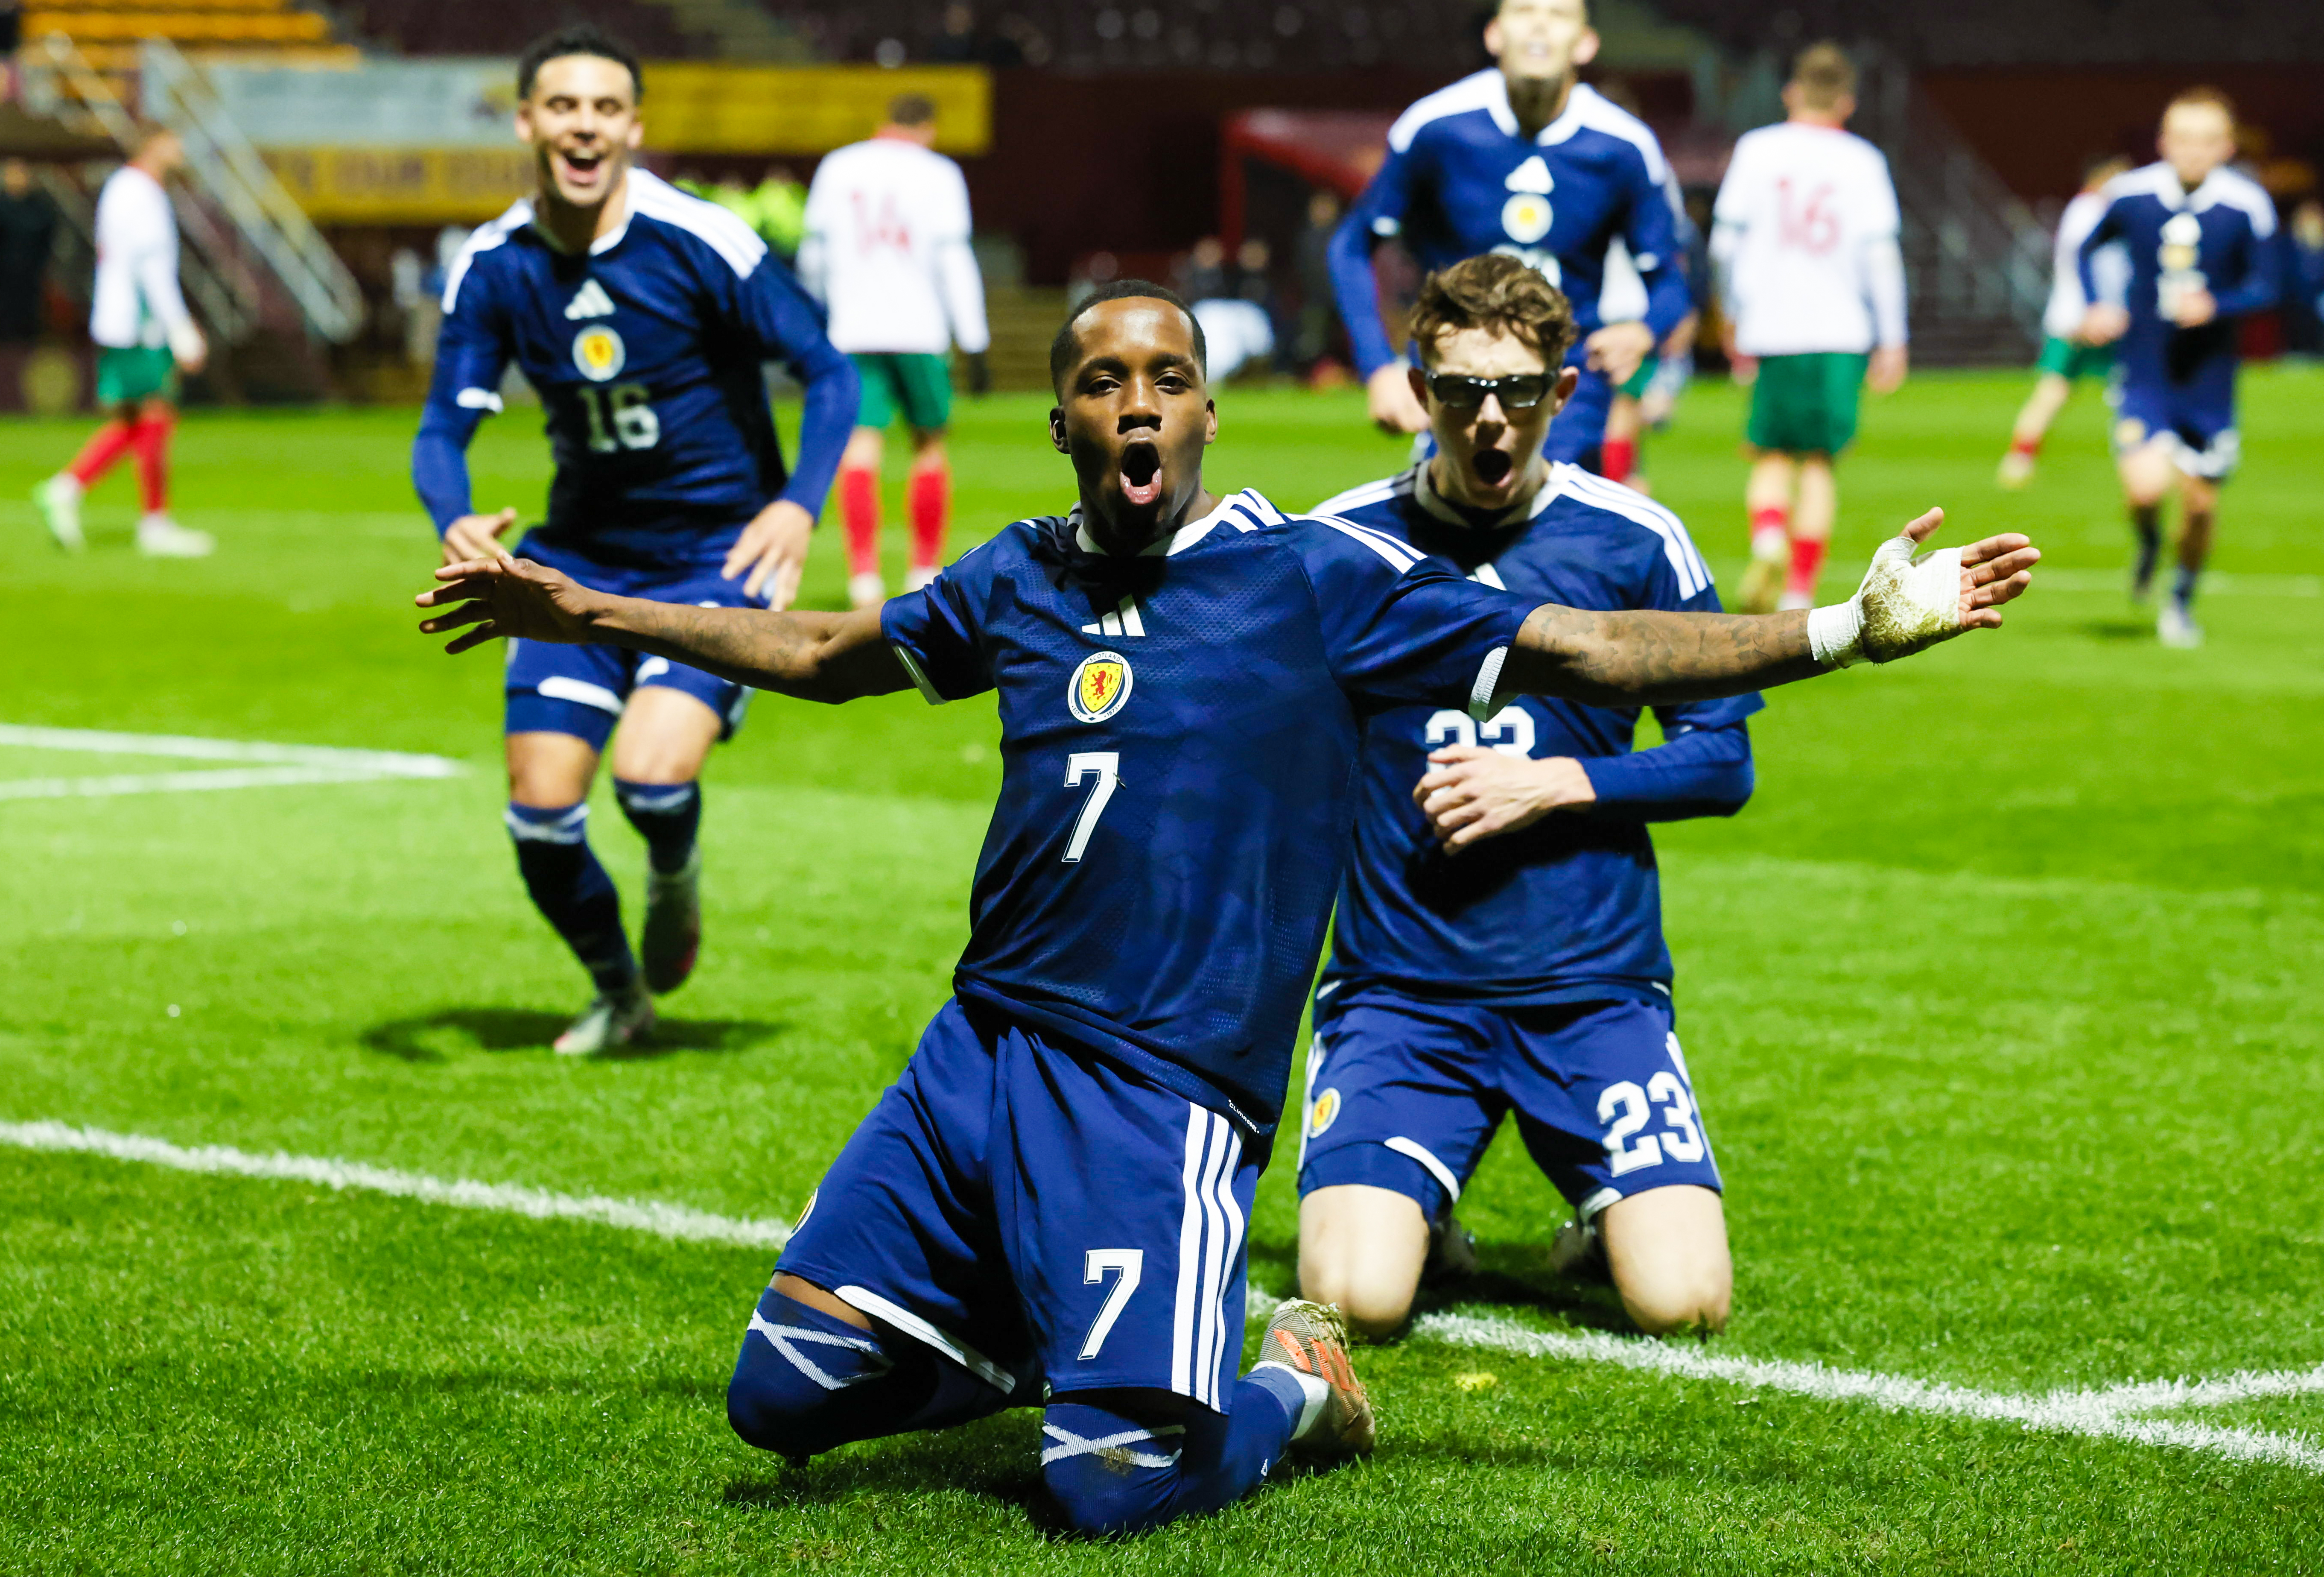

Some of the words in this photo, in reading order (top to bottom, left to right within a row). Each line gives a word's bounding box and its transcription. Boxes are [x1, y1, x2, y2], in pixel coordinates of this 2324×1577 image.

[1775, 175, 1842, 258] 16
[576, 384, 660, 453] 16
[1089, 653, 1121, 662] SCOTLAND
[1072, 707, 1080, 716] EST
[1107, 706, 1118, 716] 1873
[1061, 752, 1119, 862] 7
[1597, 1071, 1705, 1178] 23
[1077, 1248, 1143, 1360] 7
